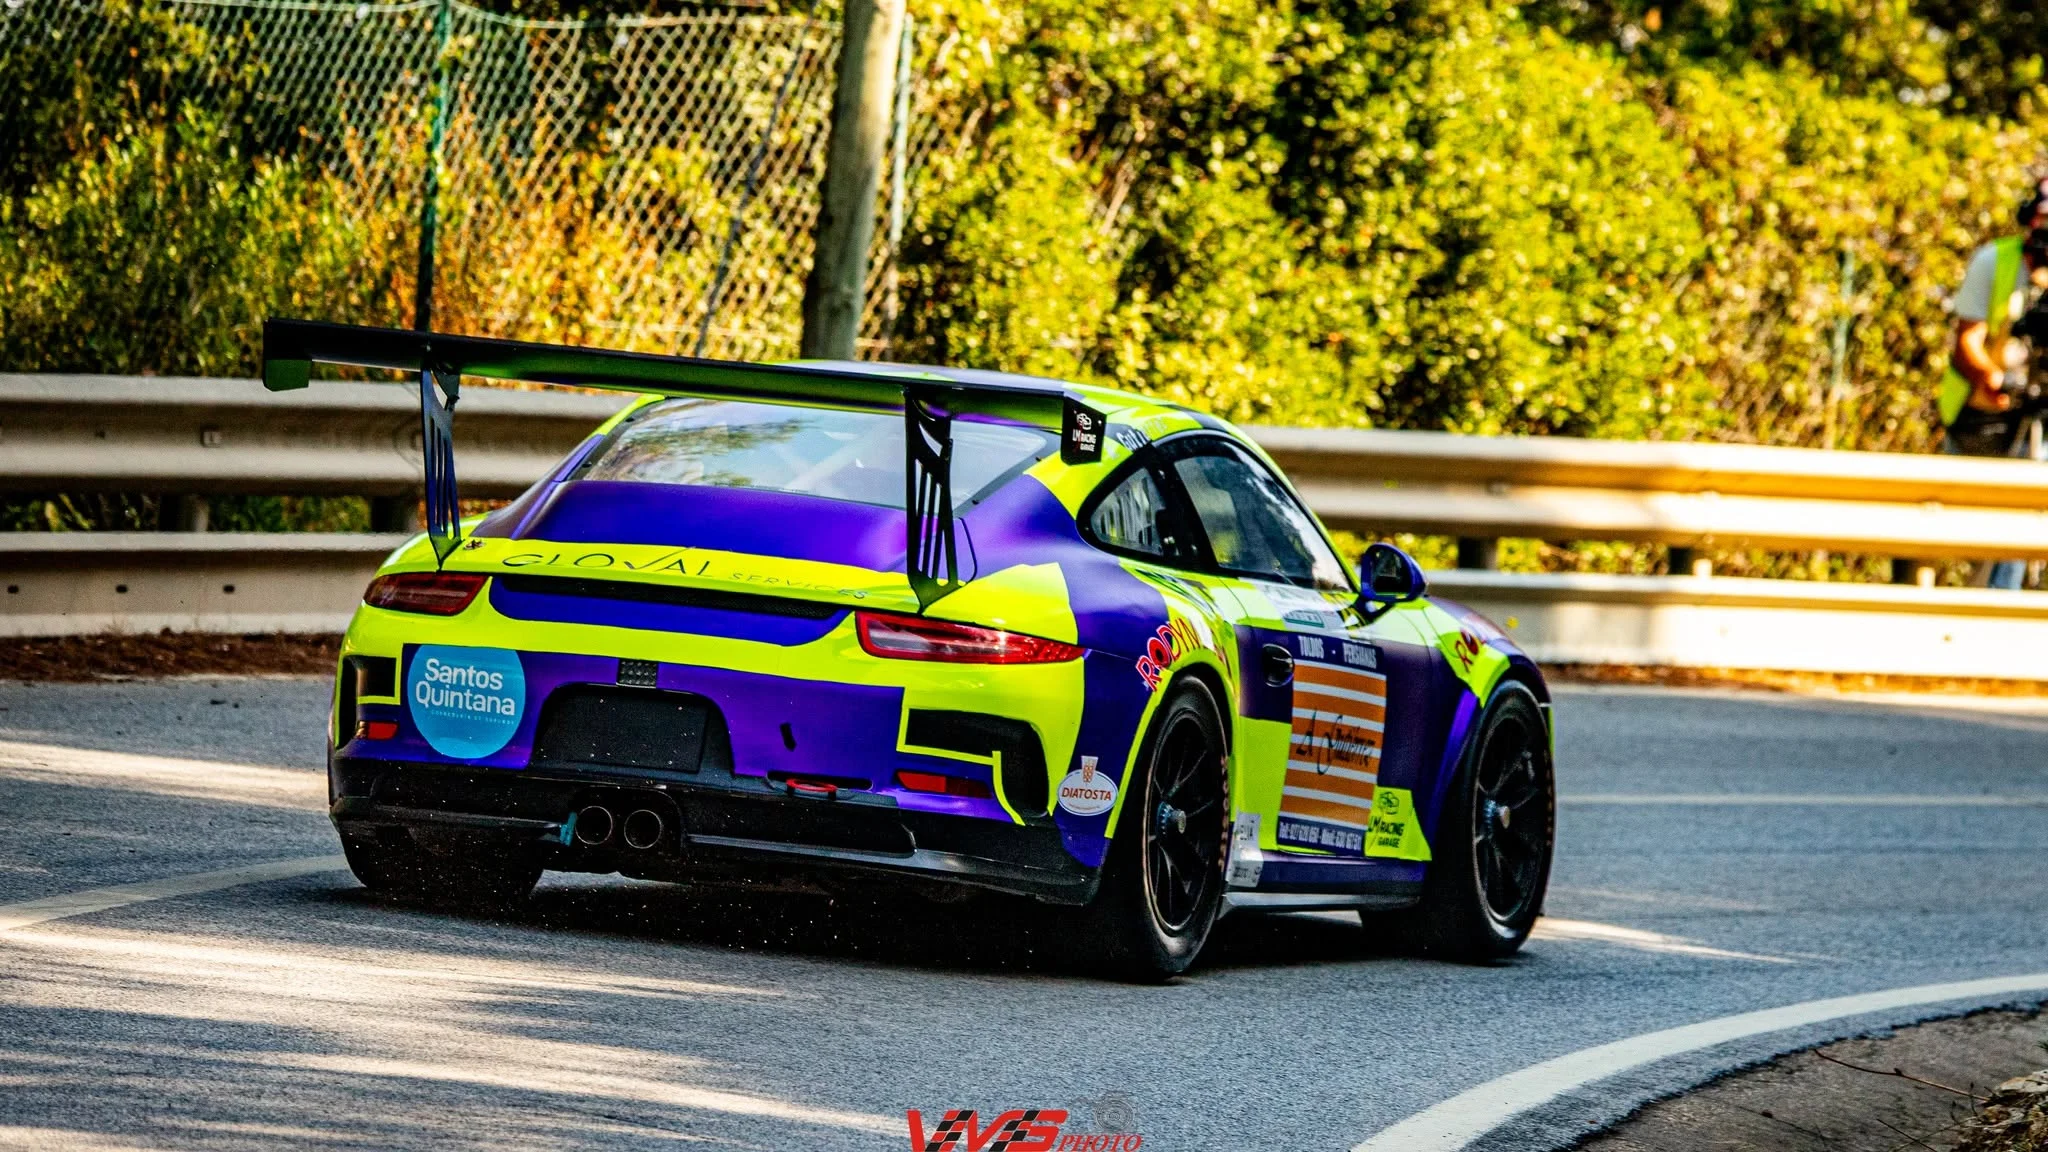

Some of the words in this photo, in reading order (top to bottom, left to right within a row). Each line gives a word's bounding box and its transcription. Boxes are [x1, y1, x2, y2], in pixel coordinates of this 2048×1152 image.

[425, 658, 503, 690] Santos
[415, 680, 516, 716] Quintana
[1061, 787, 1112, 801] DIATOSTA
